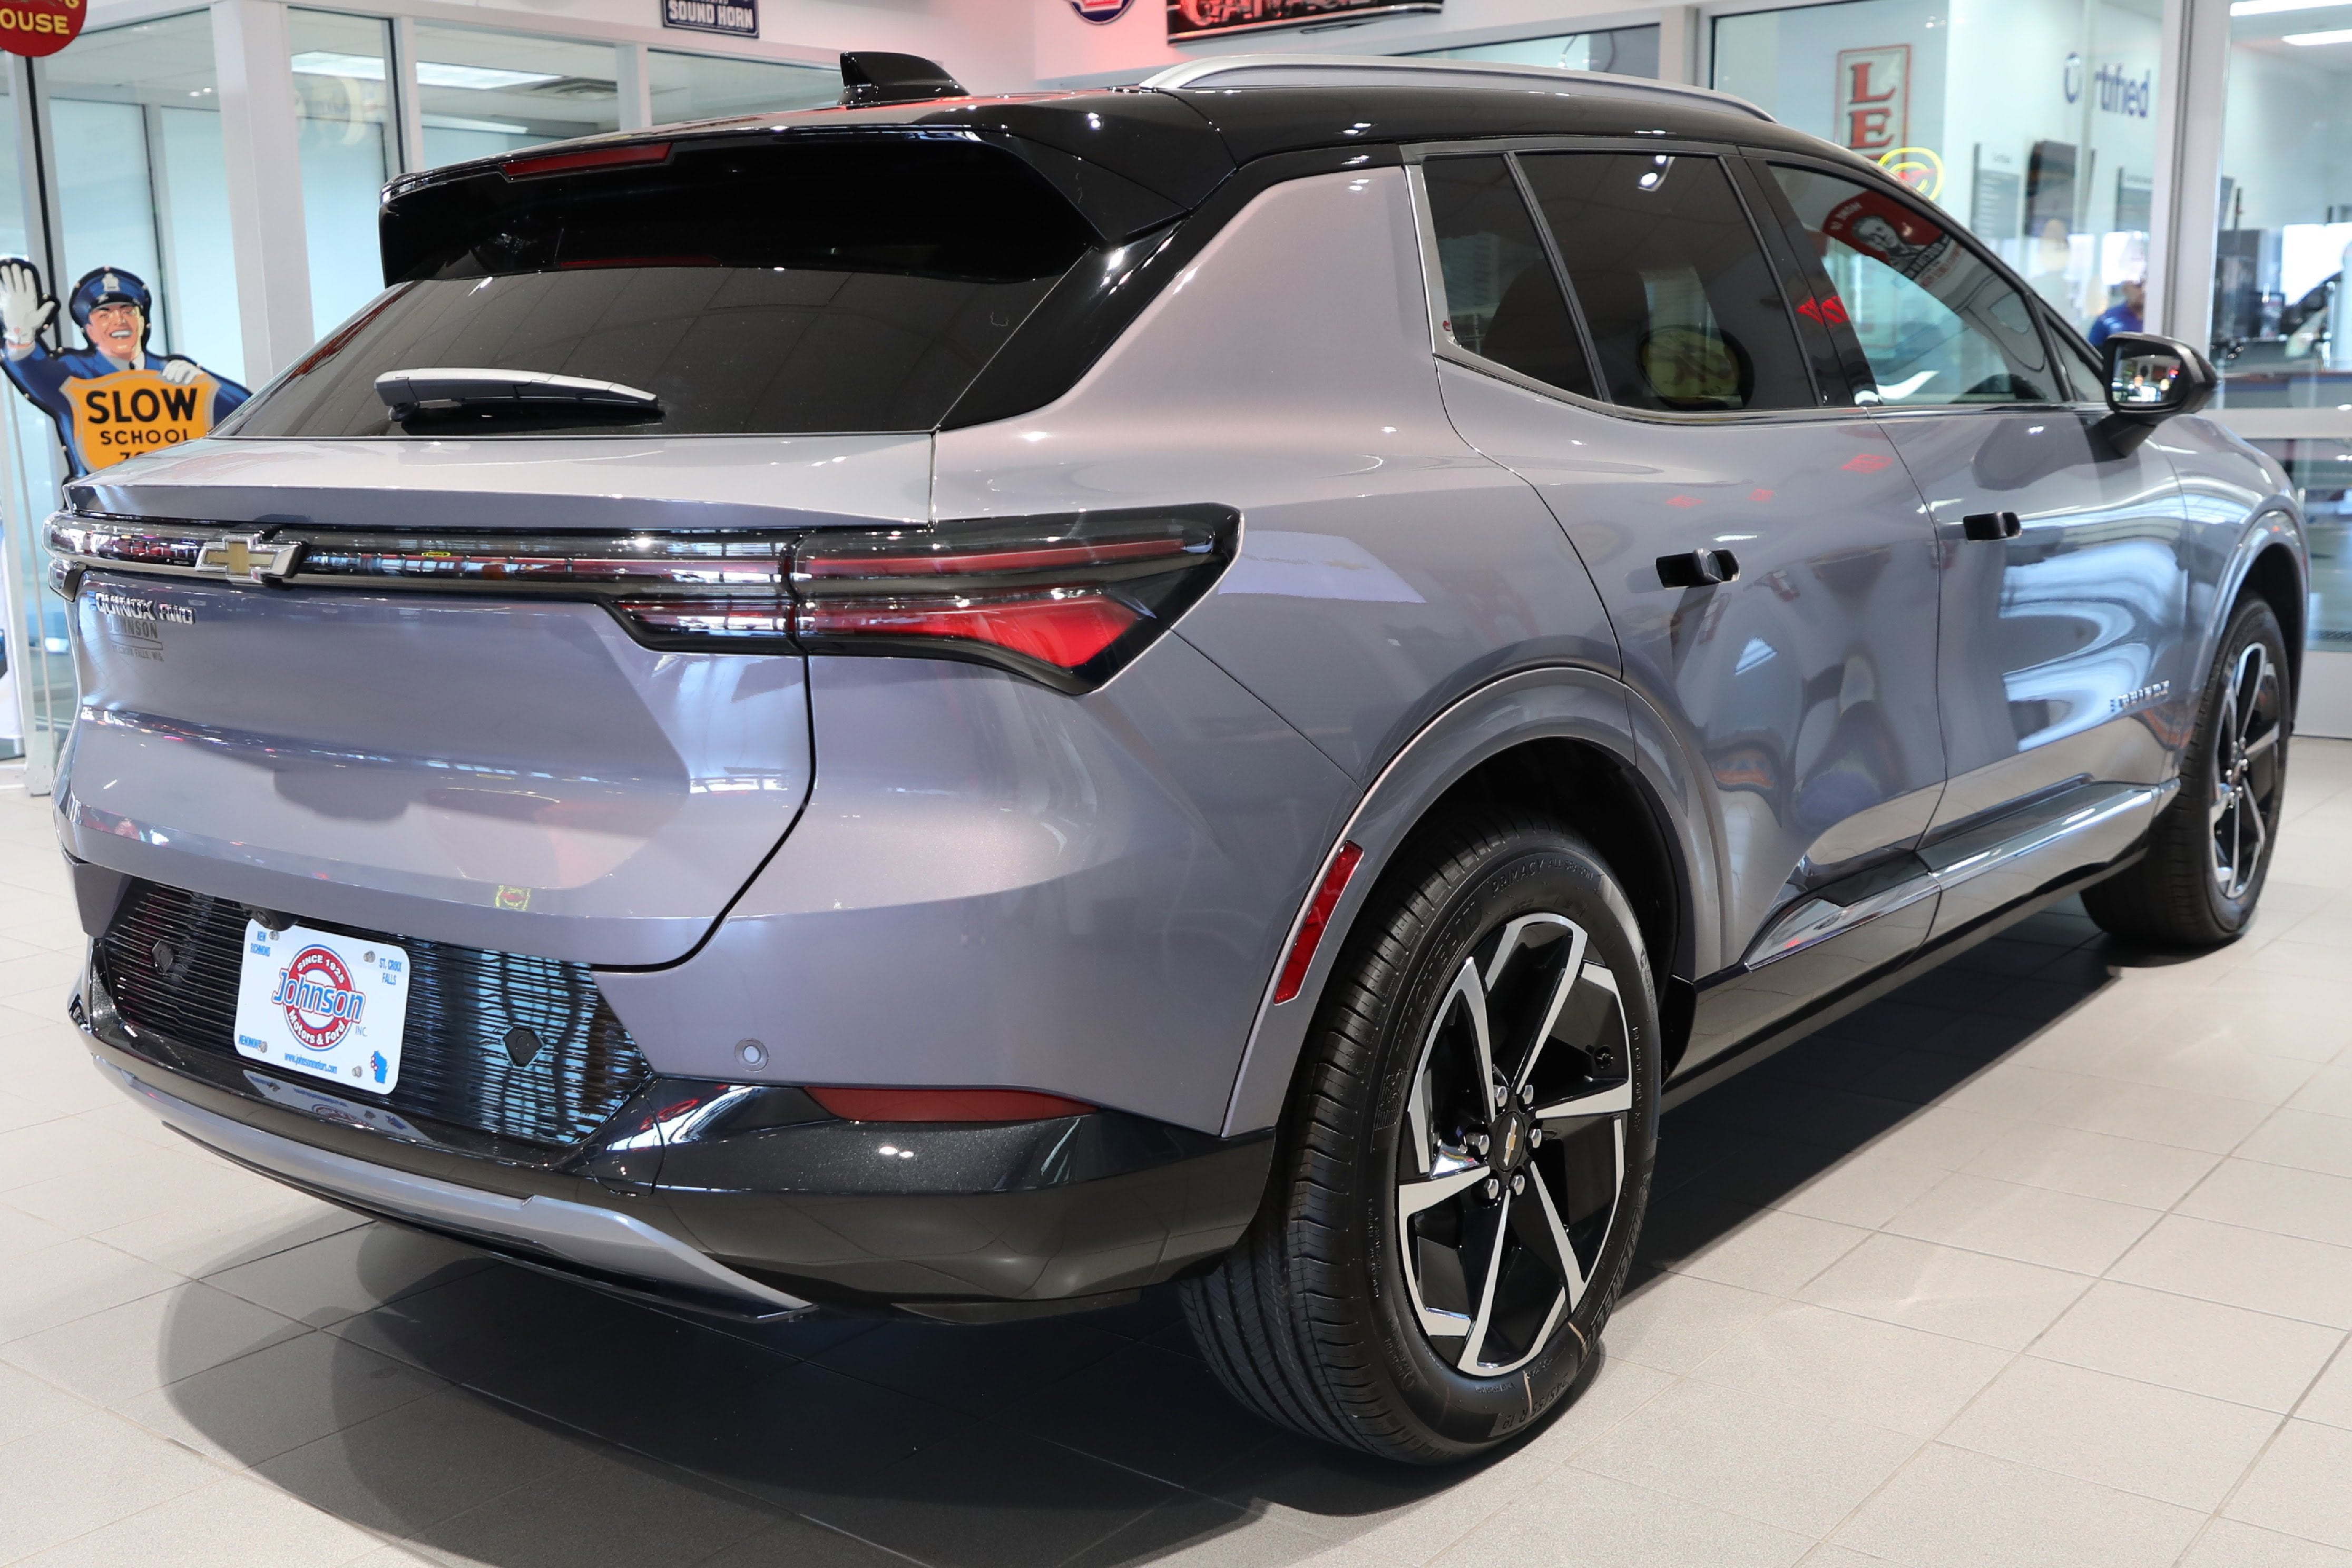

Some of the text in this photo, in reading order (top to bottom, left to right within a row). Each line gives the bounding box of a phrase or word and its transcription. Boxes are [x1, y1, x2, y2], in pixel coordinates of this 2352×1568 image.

[669, 1, 715, 24] SOUND
[717, 5, 754, 28] HORN
[86, 388, 197, 424] SLOW
[100, 429, 188, 445] SCHOOL
[86, 590, 195, 625] EQUINOX AWD
[1492, 858, 1594, 898] PRIMACY ALL SEASON
[297, 955, 324, 972] SINCE
[388, 959, 402, 972] CROIX
[381, 972, 397, 986] FALLS
[272, 971, 365, 1021] Johnson
[289, 1008, 346, 1045] Motors & Ford
[1502, 1412, 1516, 1429] 19
[1519, 1407, 1529, 1423] R
